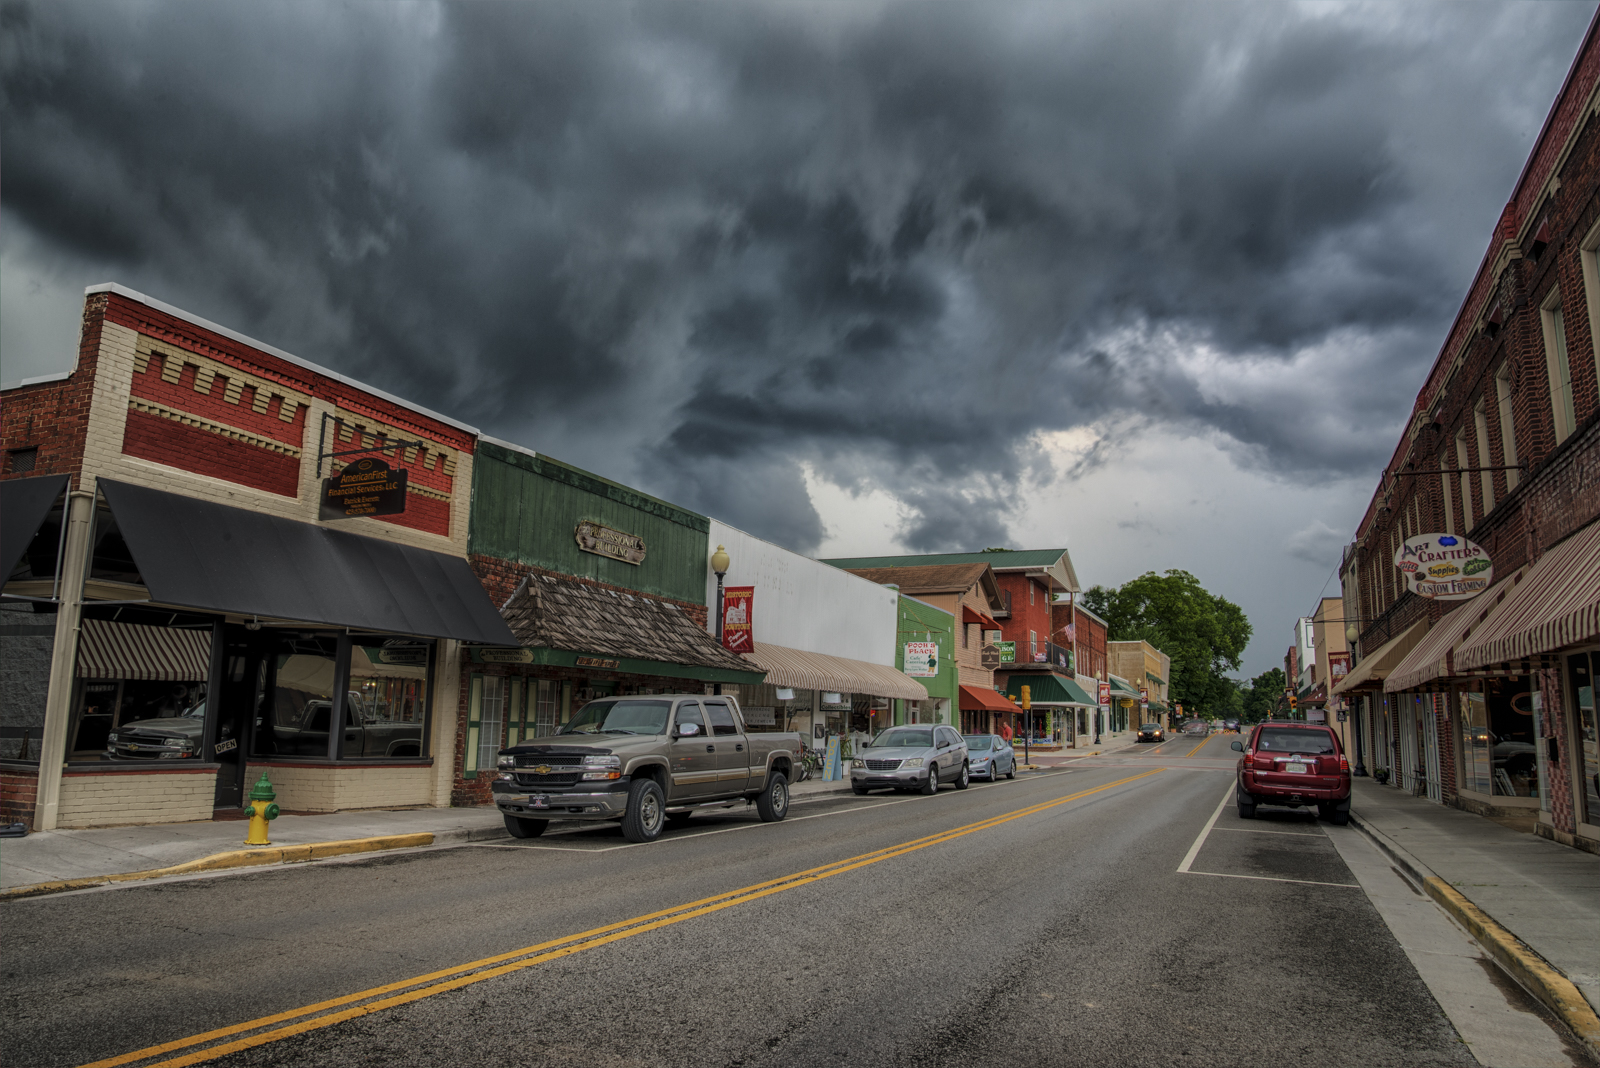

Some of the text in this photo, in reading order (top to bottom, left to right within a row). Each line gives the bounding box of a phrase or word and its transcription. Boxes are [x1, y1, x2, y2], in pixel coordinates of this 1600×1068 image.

[340, 470, 388, 483] AmericanFirst
[328, 486, 356, 497] Financial
[385, 481, 399, 490] LLC
[590, 526, 640, 550] PROFESSIONAL
[595, 540, 629, 557] BUILDING
[1418, 545, 1481, 563] CRAFTERS
[1399, 561, 1419, 572] Gifts
[1427, 564, 1460, 576] Supplies
[726, 591, 752, 599] HISTORIC
[216, 740, 236, 752] OPEN
[824, 738, 837, 780] OPEN
